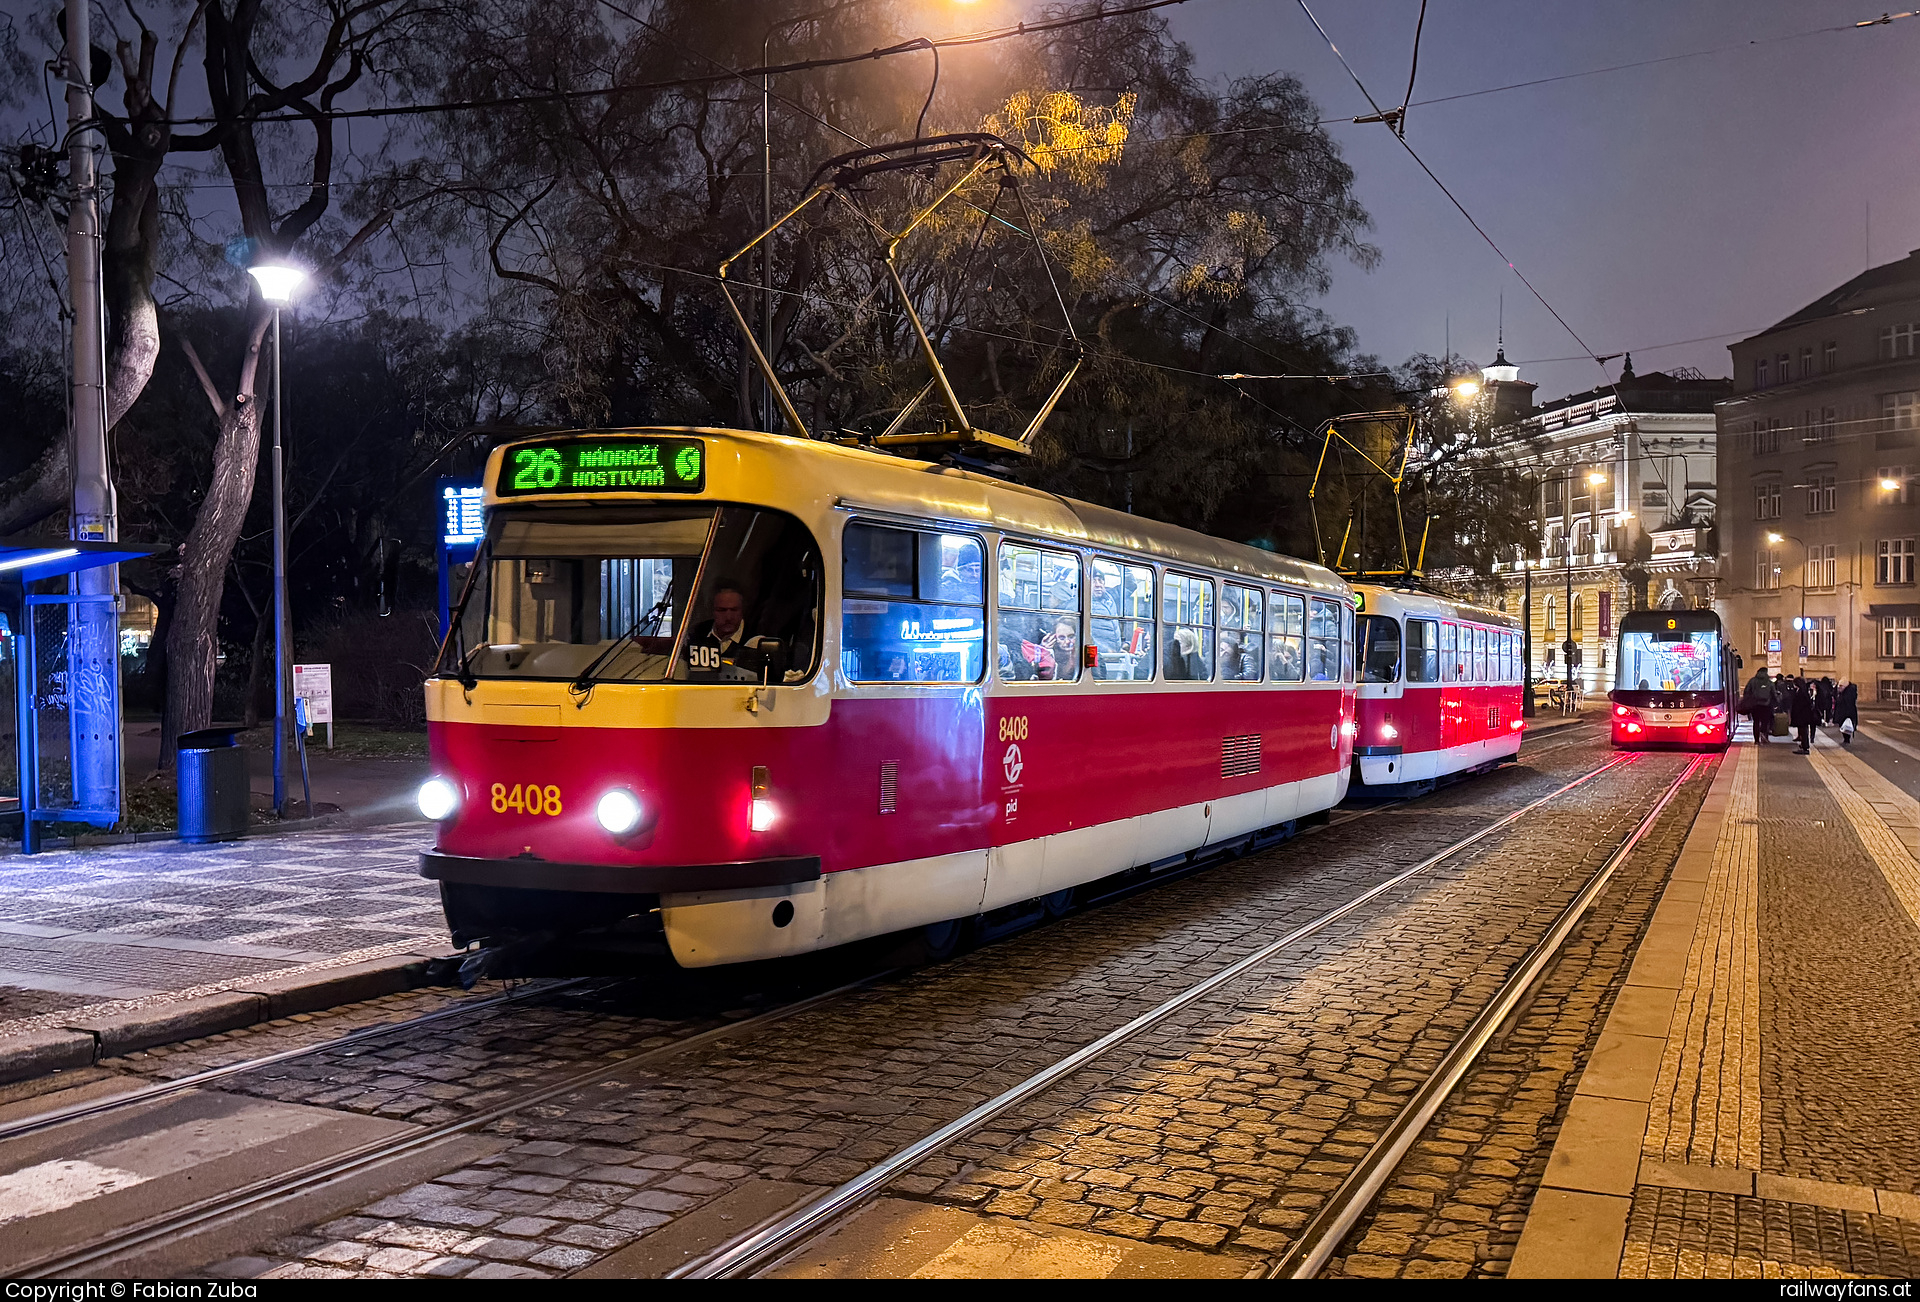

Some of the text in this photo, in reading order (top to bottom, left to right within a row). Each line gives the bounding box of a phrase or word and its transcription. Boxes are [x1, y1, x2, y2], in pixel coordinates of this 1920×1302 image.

[579, 444, 660, 467] NÁDRAŽÍ
[514, 448, 561, 489] 26
[572, 465, 665, 487] HOSTIVAŘ
[1667, 619, 1676, 629] 9
[689, 645, 720, 668] 505
[999, 716, 1028, 742] 8408
[491, 782, 563, 817] 8408
[1006, 798, 1017, 817] pid
